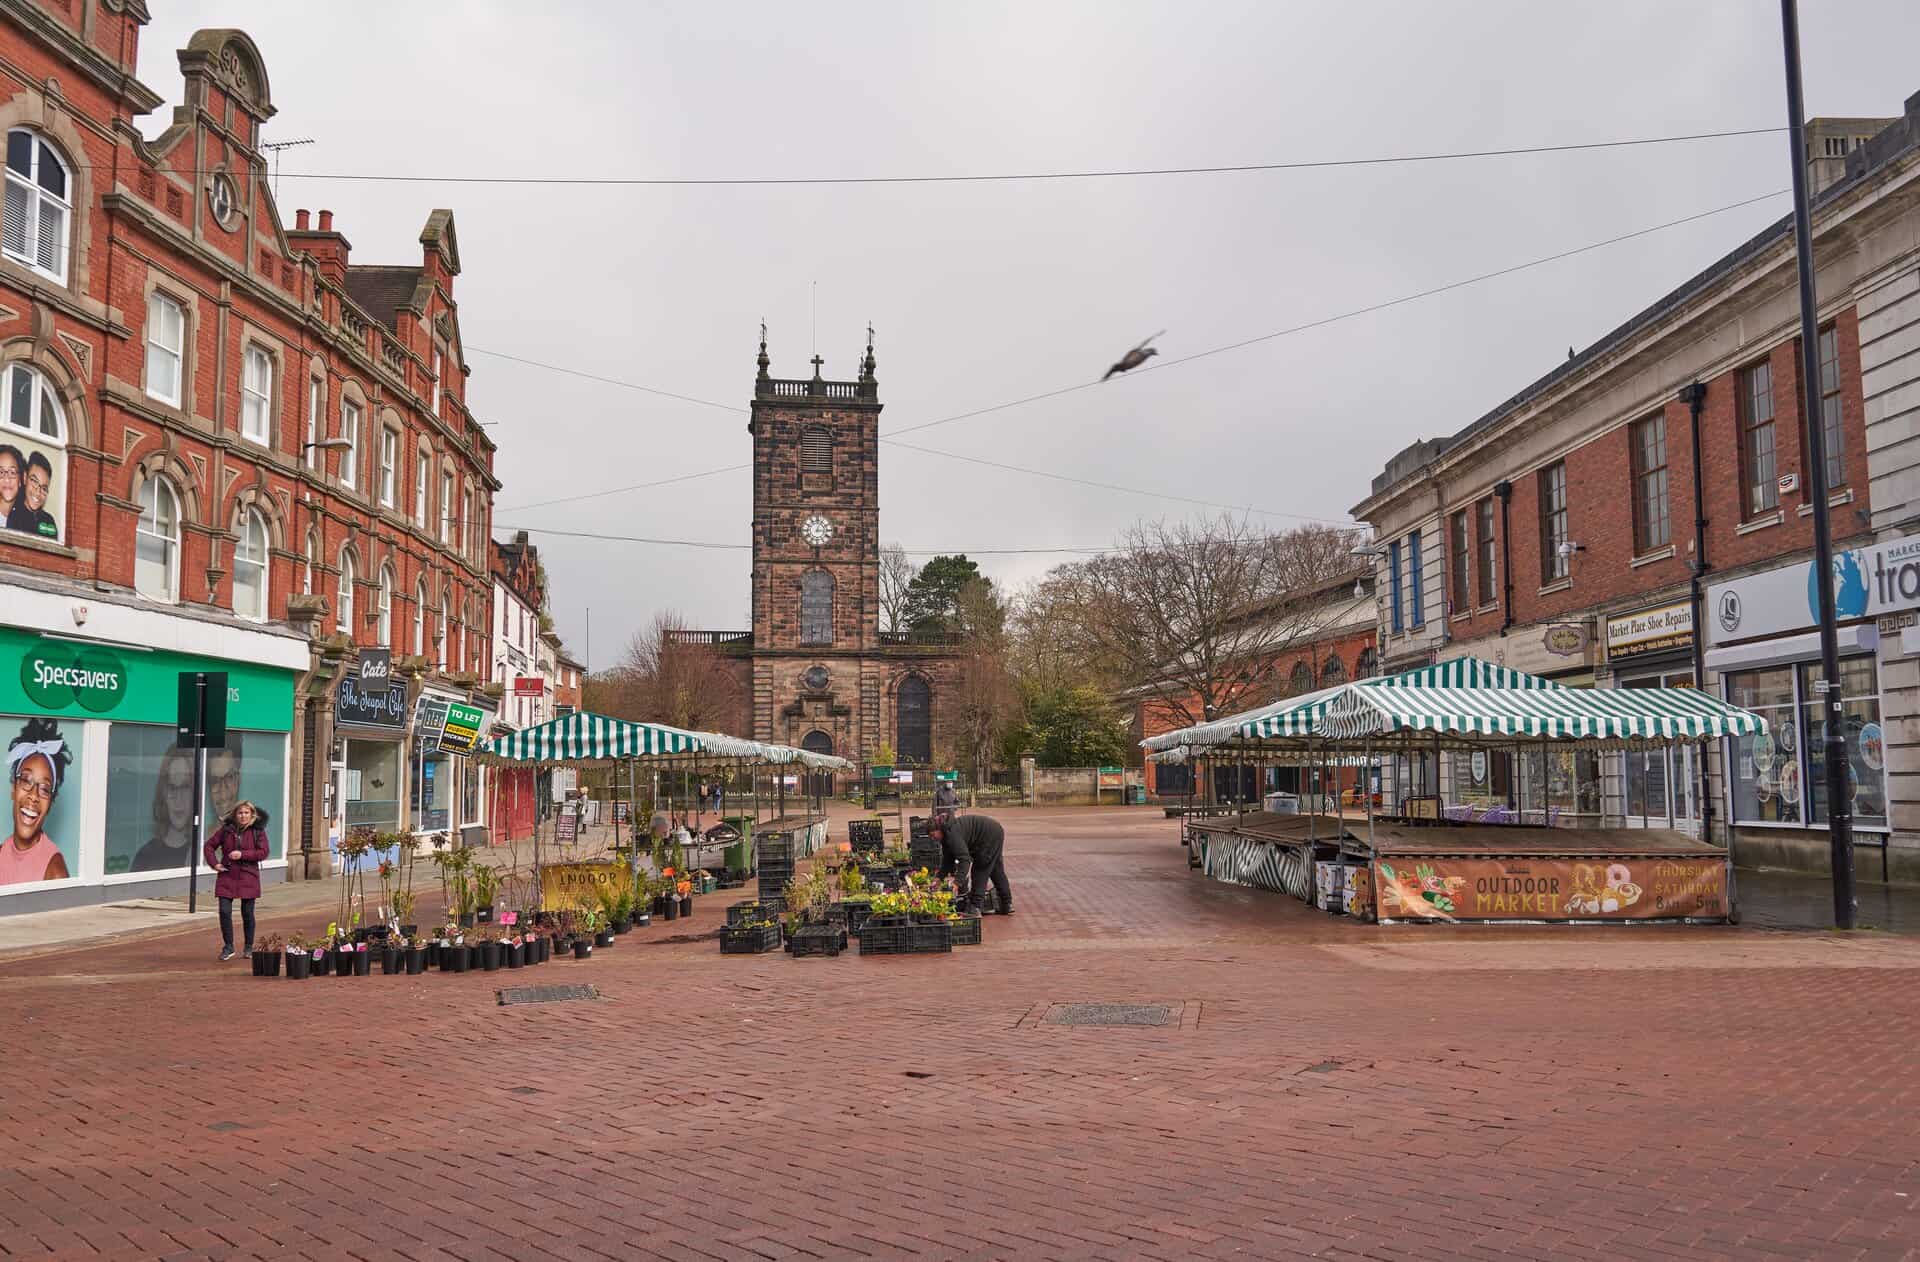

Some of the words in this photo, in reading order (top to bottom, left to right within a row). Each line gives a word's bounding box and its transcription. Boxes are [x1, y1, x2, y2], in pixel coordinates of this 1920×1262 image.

[1609, 623, 1629, 639] Market
[1631, 619, 1646, 634] Place
[1647, 615, 1663, 631] Shoe
[1665, 607, 1691, 631] Repairs
[33, 659, 118, 691] Specsavers
[340, 680, 358, 709] The
[451, 709, 463, 719] TO
[464, 711, 480, 723] LET
[1476, 877, 1560, 894] OUTDOOR
[1655, 881, 1719, 895] SATURDAY
[1476, 894, 1560, 912] MARKET
